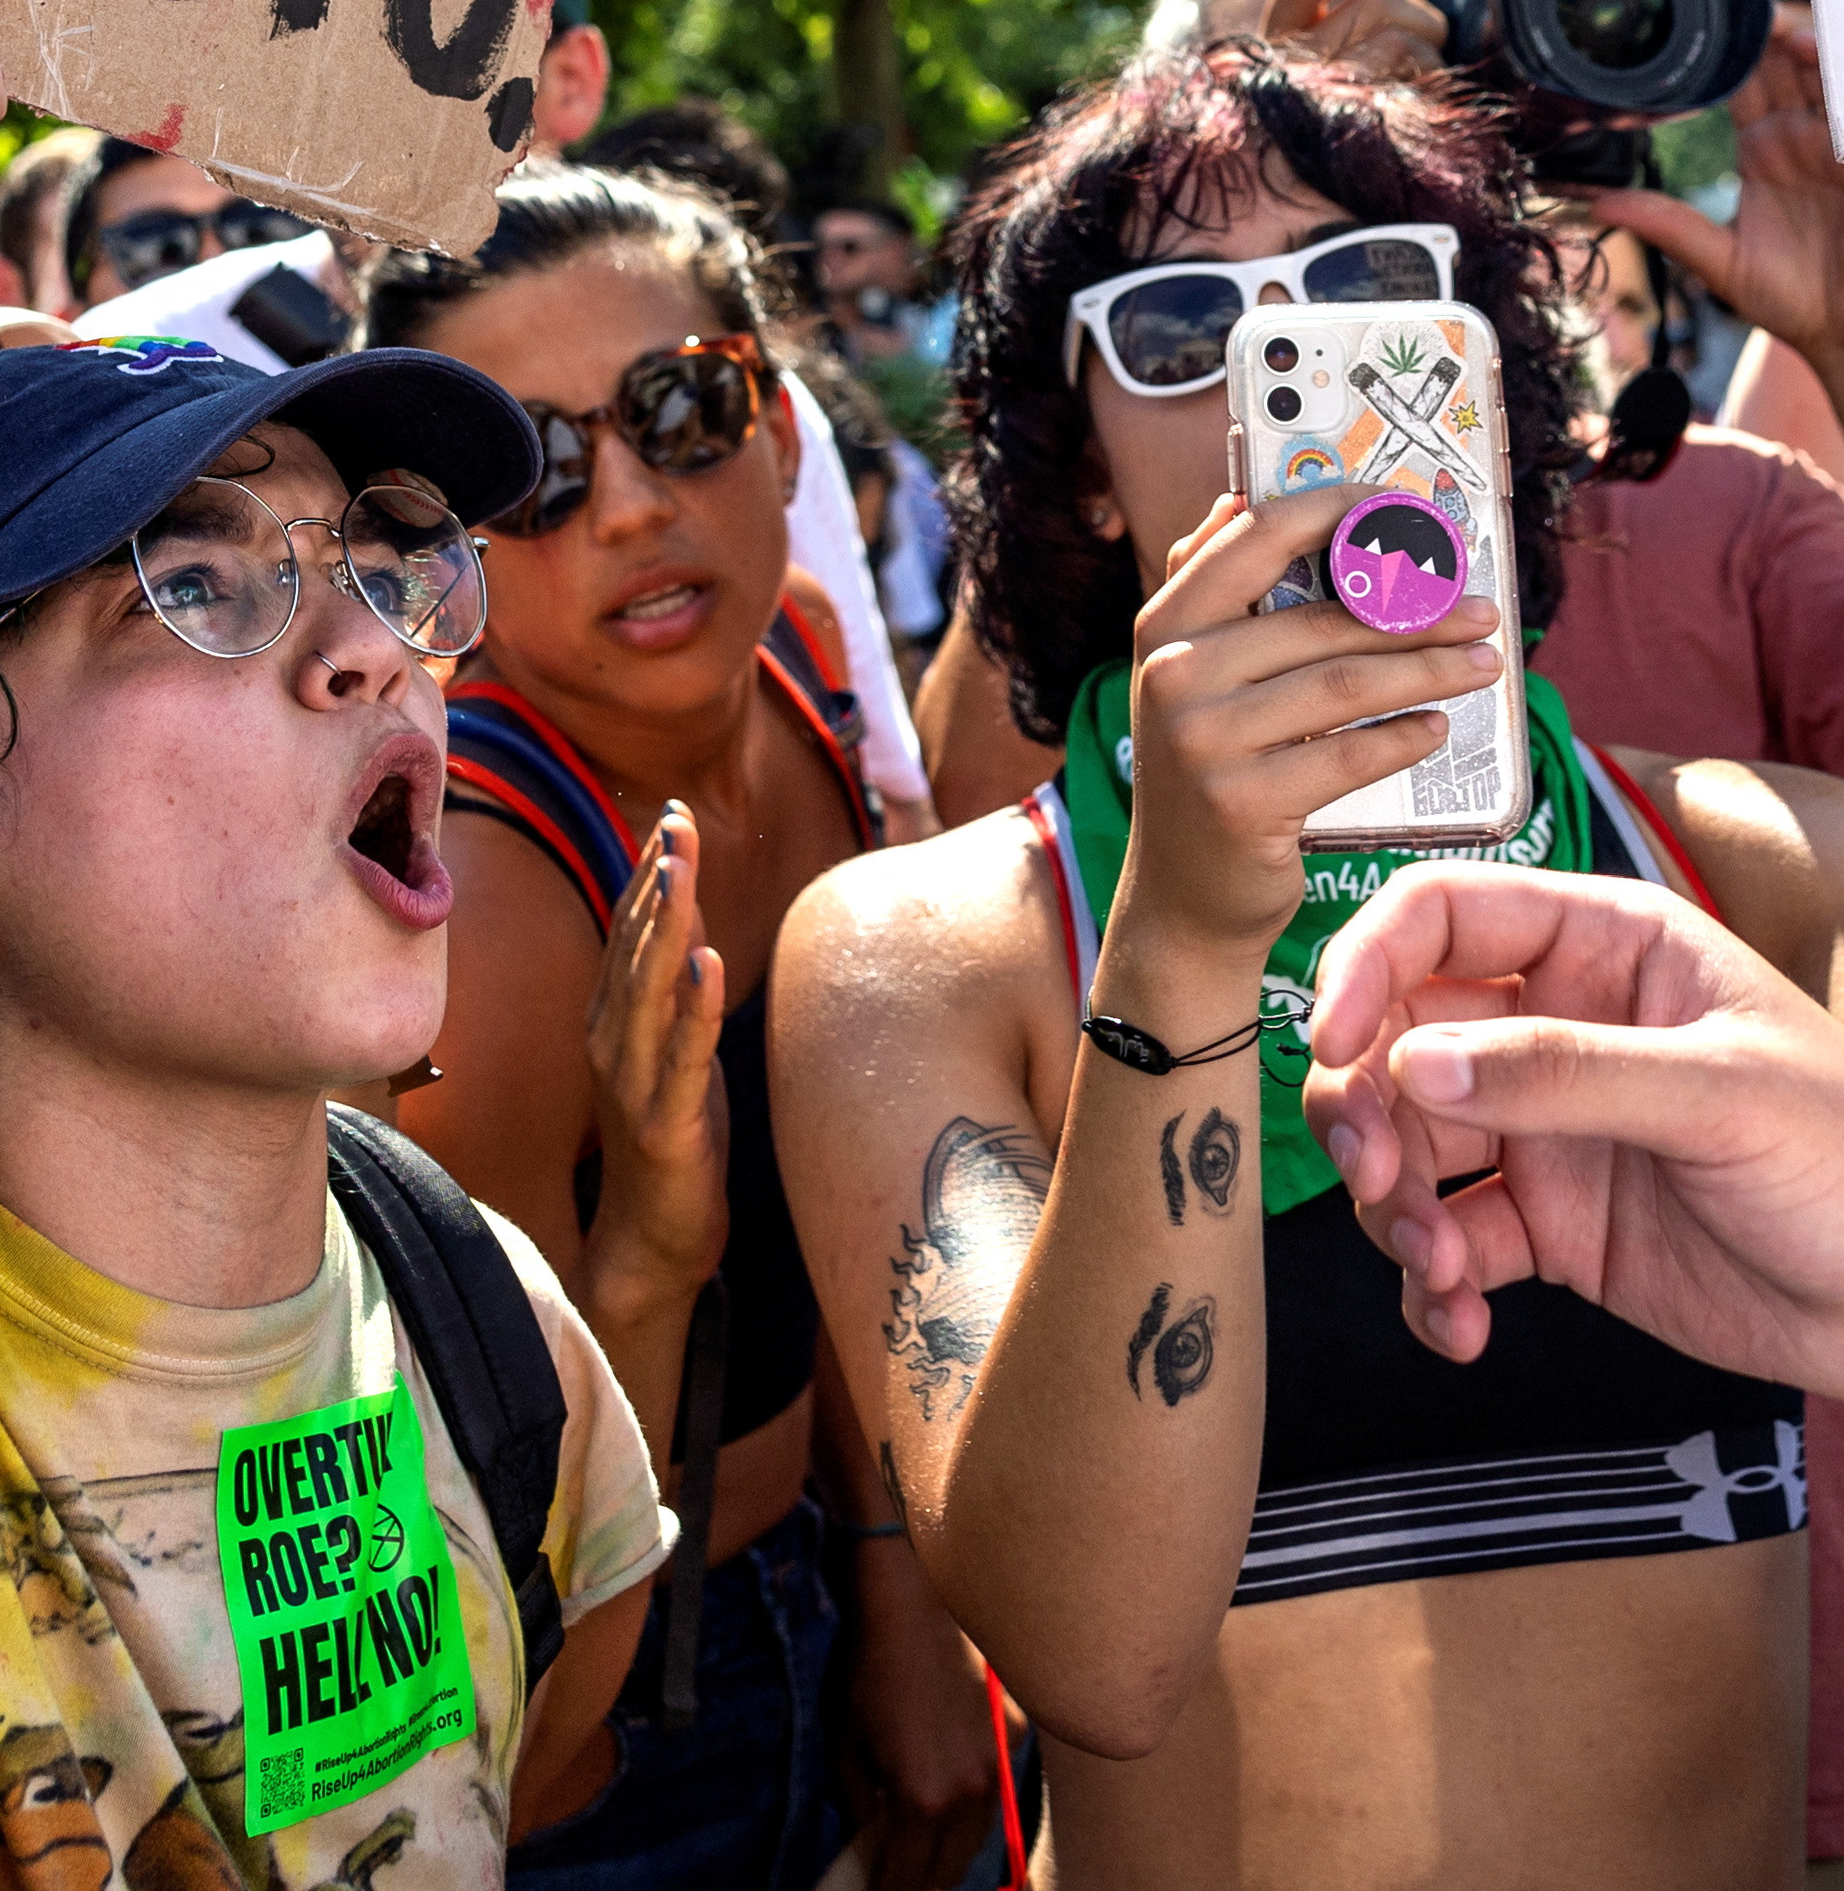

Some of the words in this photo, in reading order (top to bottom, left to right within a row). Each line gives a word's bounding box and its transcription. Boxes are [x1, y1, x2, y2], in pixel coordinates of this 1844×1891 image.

[238, 1514, 362, 1618] ROE?
[259, 1609, 372, 1736] HELL
[365, 1564, 441, 1688] NO!
[312, 1708, 463, 1802] RiseUp4AbortionRights.org
